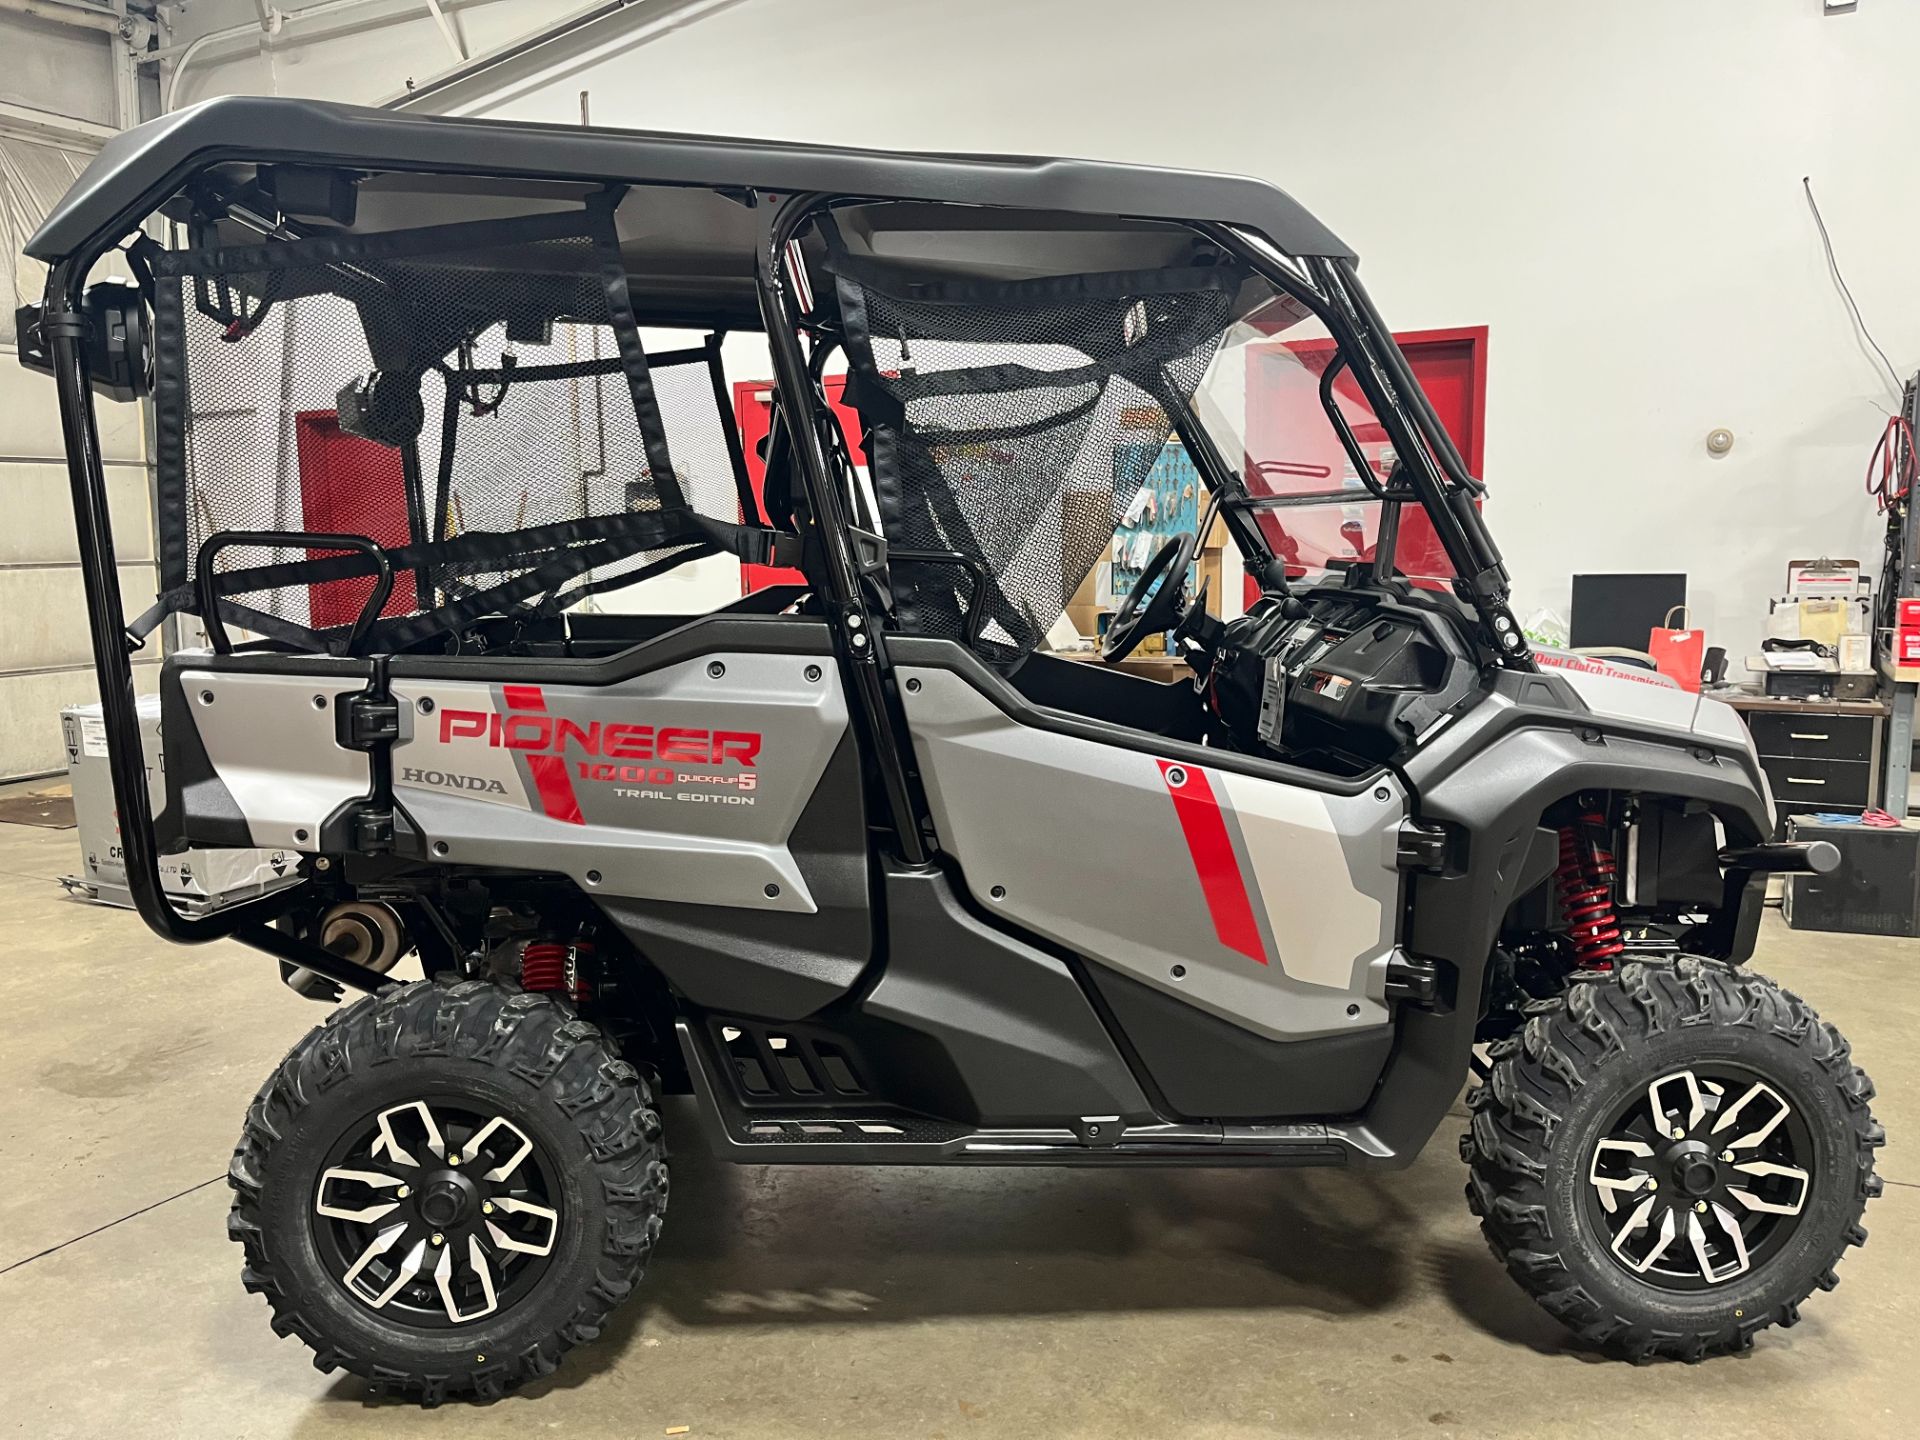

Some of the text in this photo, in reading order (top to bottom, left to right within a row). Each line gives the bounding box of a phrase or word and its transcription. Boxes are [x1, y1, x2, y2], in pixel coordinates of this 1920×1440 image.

[1534, 651, 1564, 668] Dual
[1566, 657, 1604, 676] Clutch
[440, 709, 762, 767] PIONEER
[401, 767, 508, 794] HONDA
[576, 762, 675, 785] 1000
[613, 788, 756, 806] TRAIL EDITION
